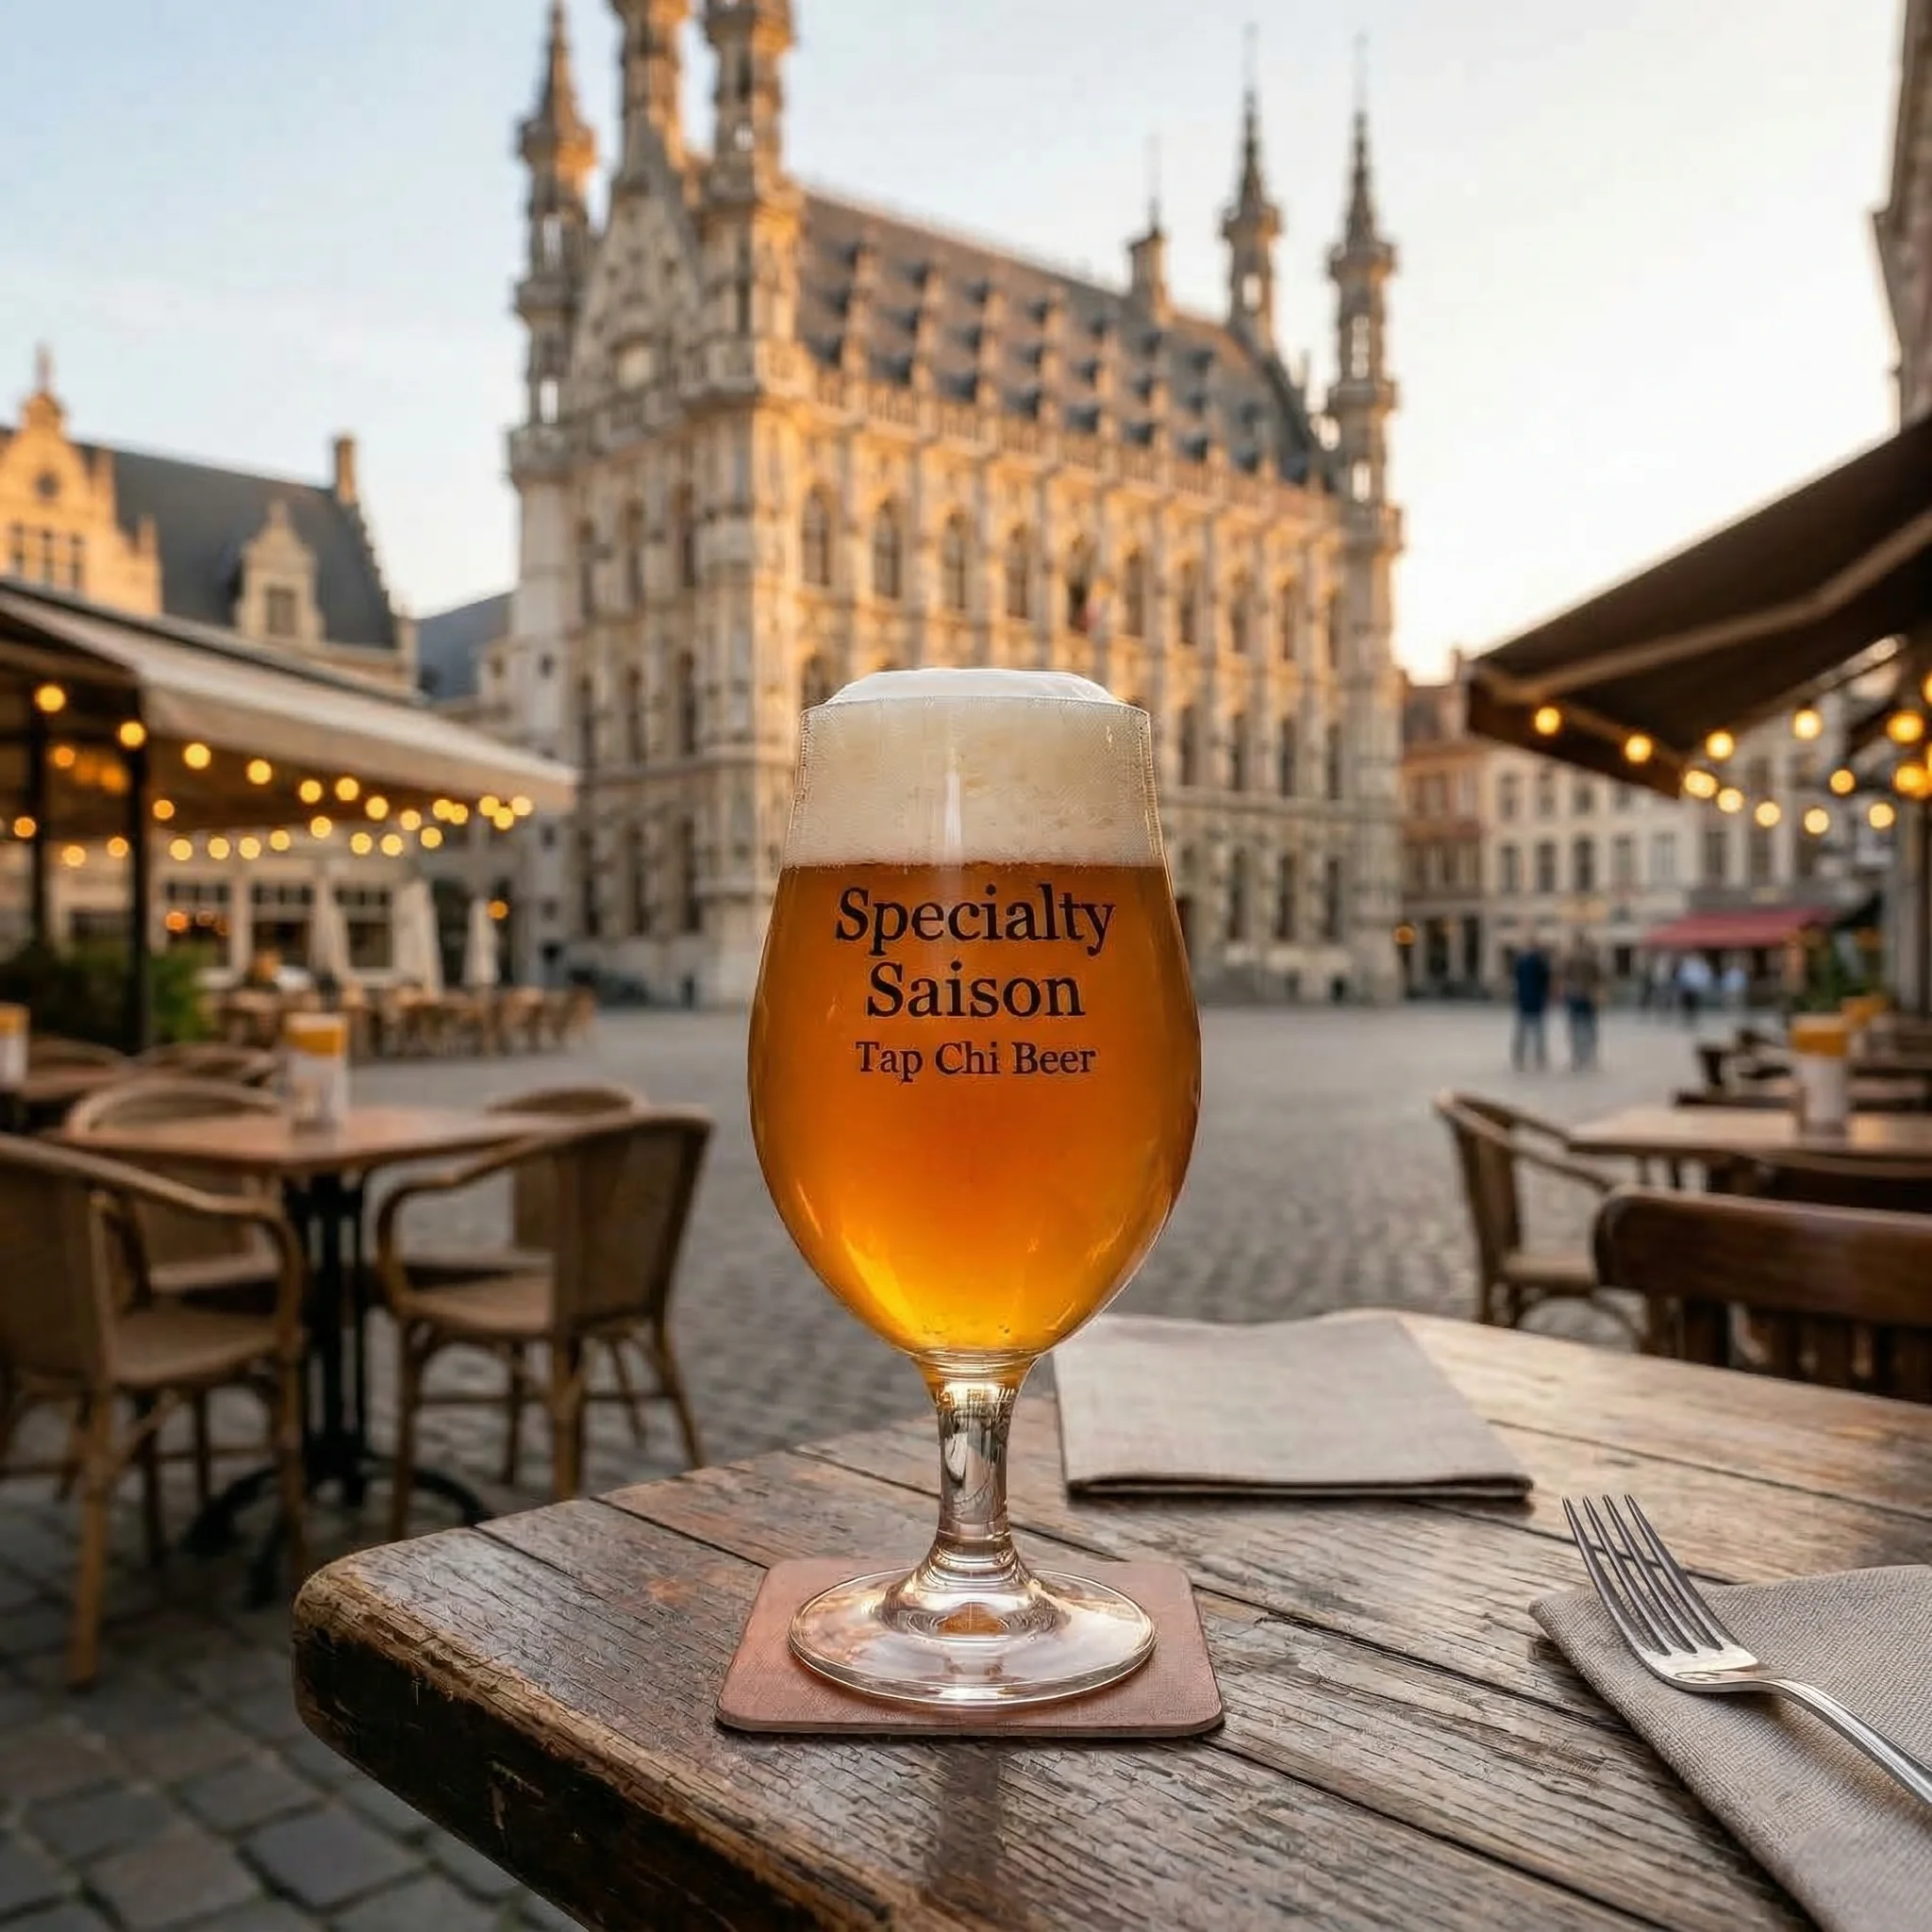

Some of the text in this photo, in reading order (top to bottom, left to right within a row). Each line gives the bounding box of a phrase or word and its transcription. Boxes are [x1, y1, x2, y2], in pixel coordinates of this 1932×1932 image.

[836, 883, 1115, 957] Specialty
[867, 960, 1086, 1018] Saison
[855, 1041, 1097, 1083] Tap Chi Beer
